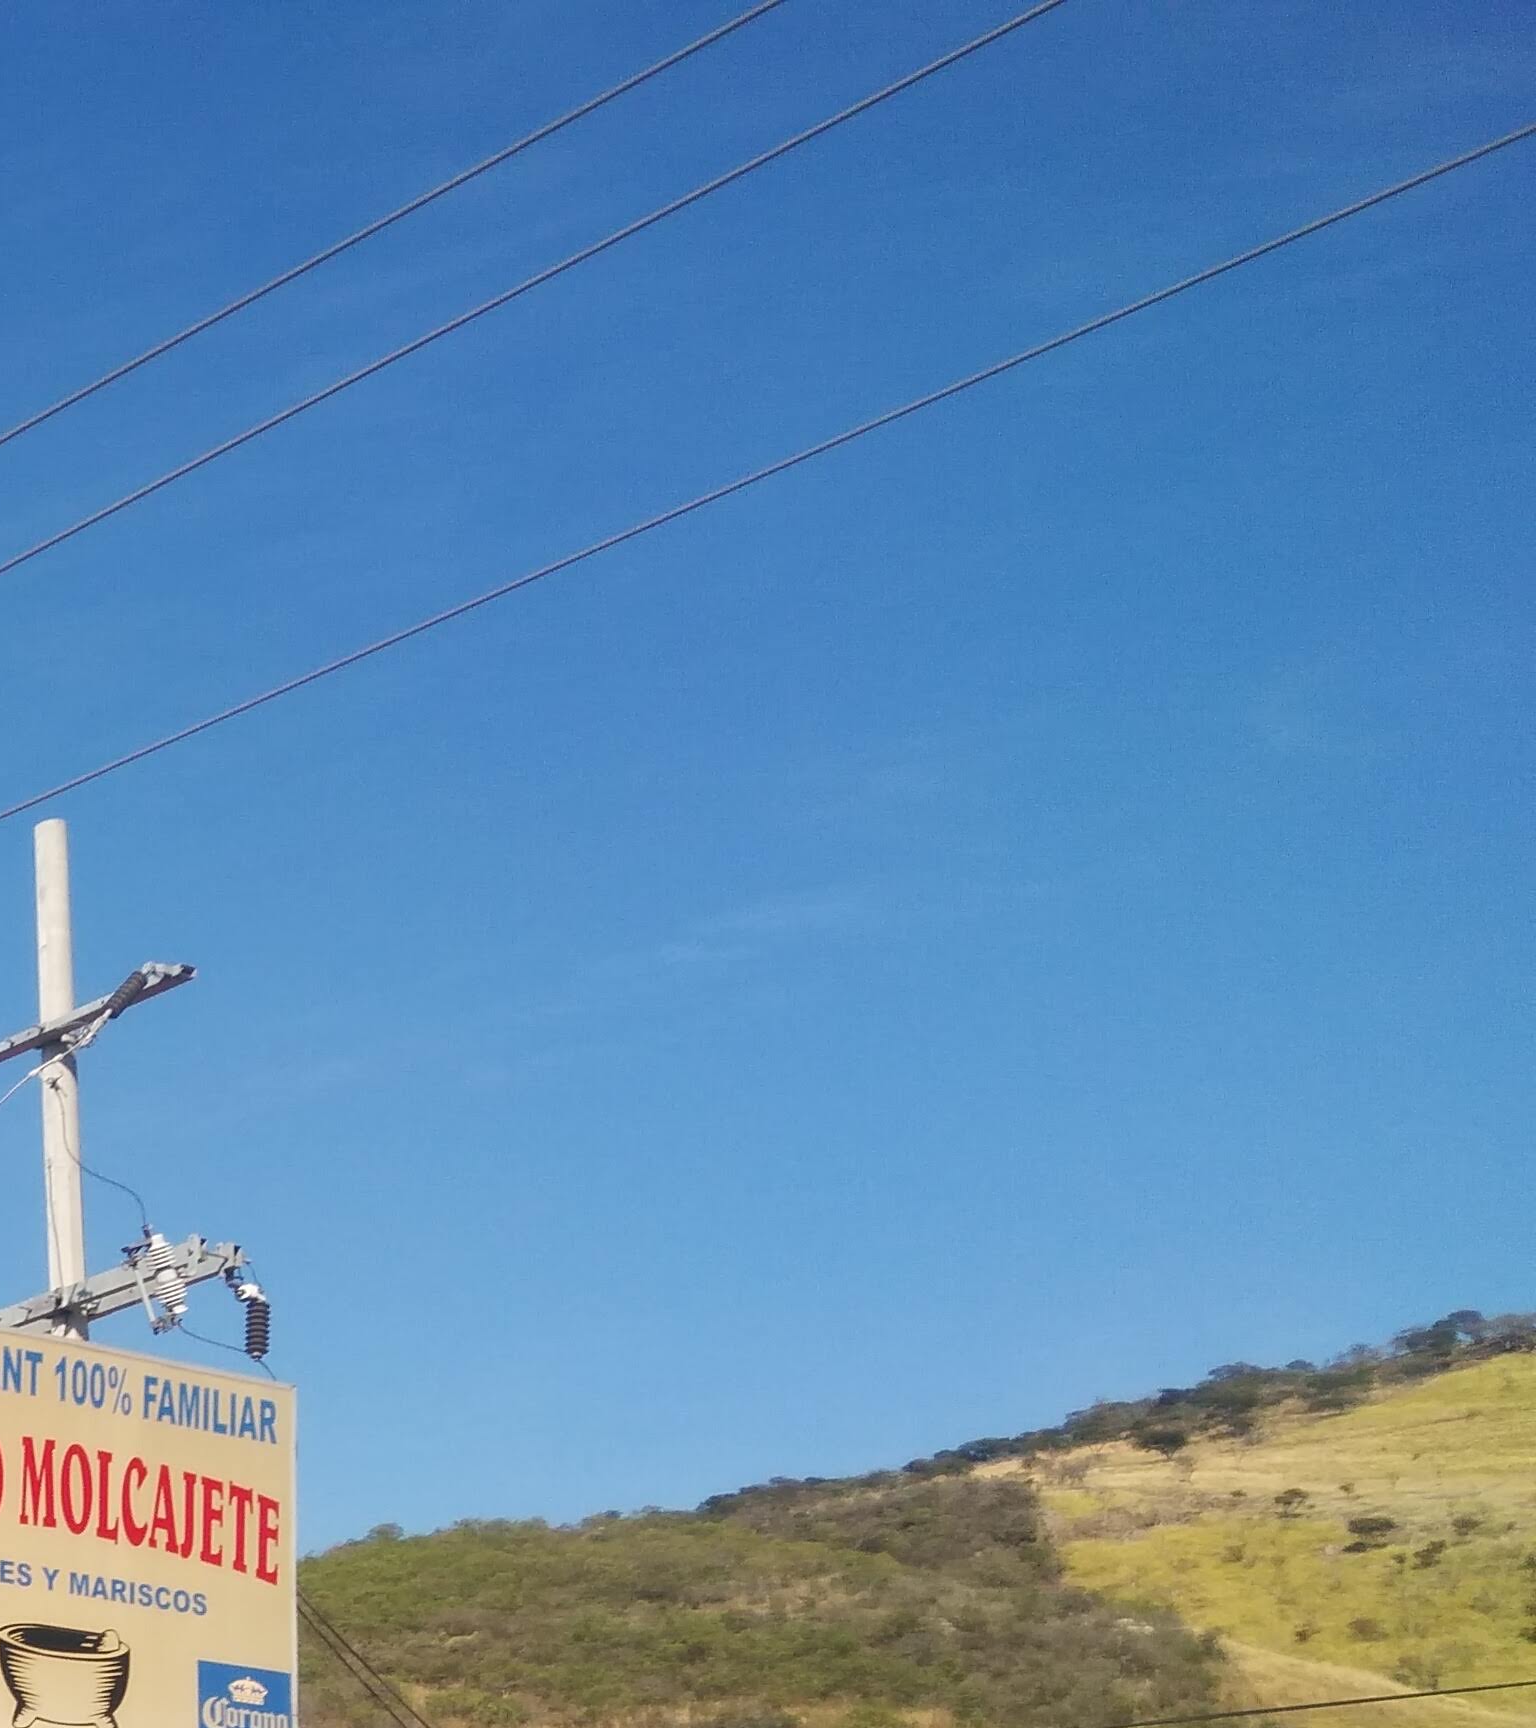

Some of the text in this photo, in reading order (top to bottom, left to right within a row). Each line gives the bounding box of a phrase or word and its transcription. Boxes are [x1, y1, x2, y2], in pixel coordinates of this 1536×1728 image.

[54, 1357, 132, 1416] 100%
[142, 1375, 278, 1444] FAMILIAR
[19, 1435, 280, 1586] MOLCAJETE
[42, 1567, 60, 1592] Y
[69, 1572, 208, 1617] MARISCOS
